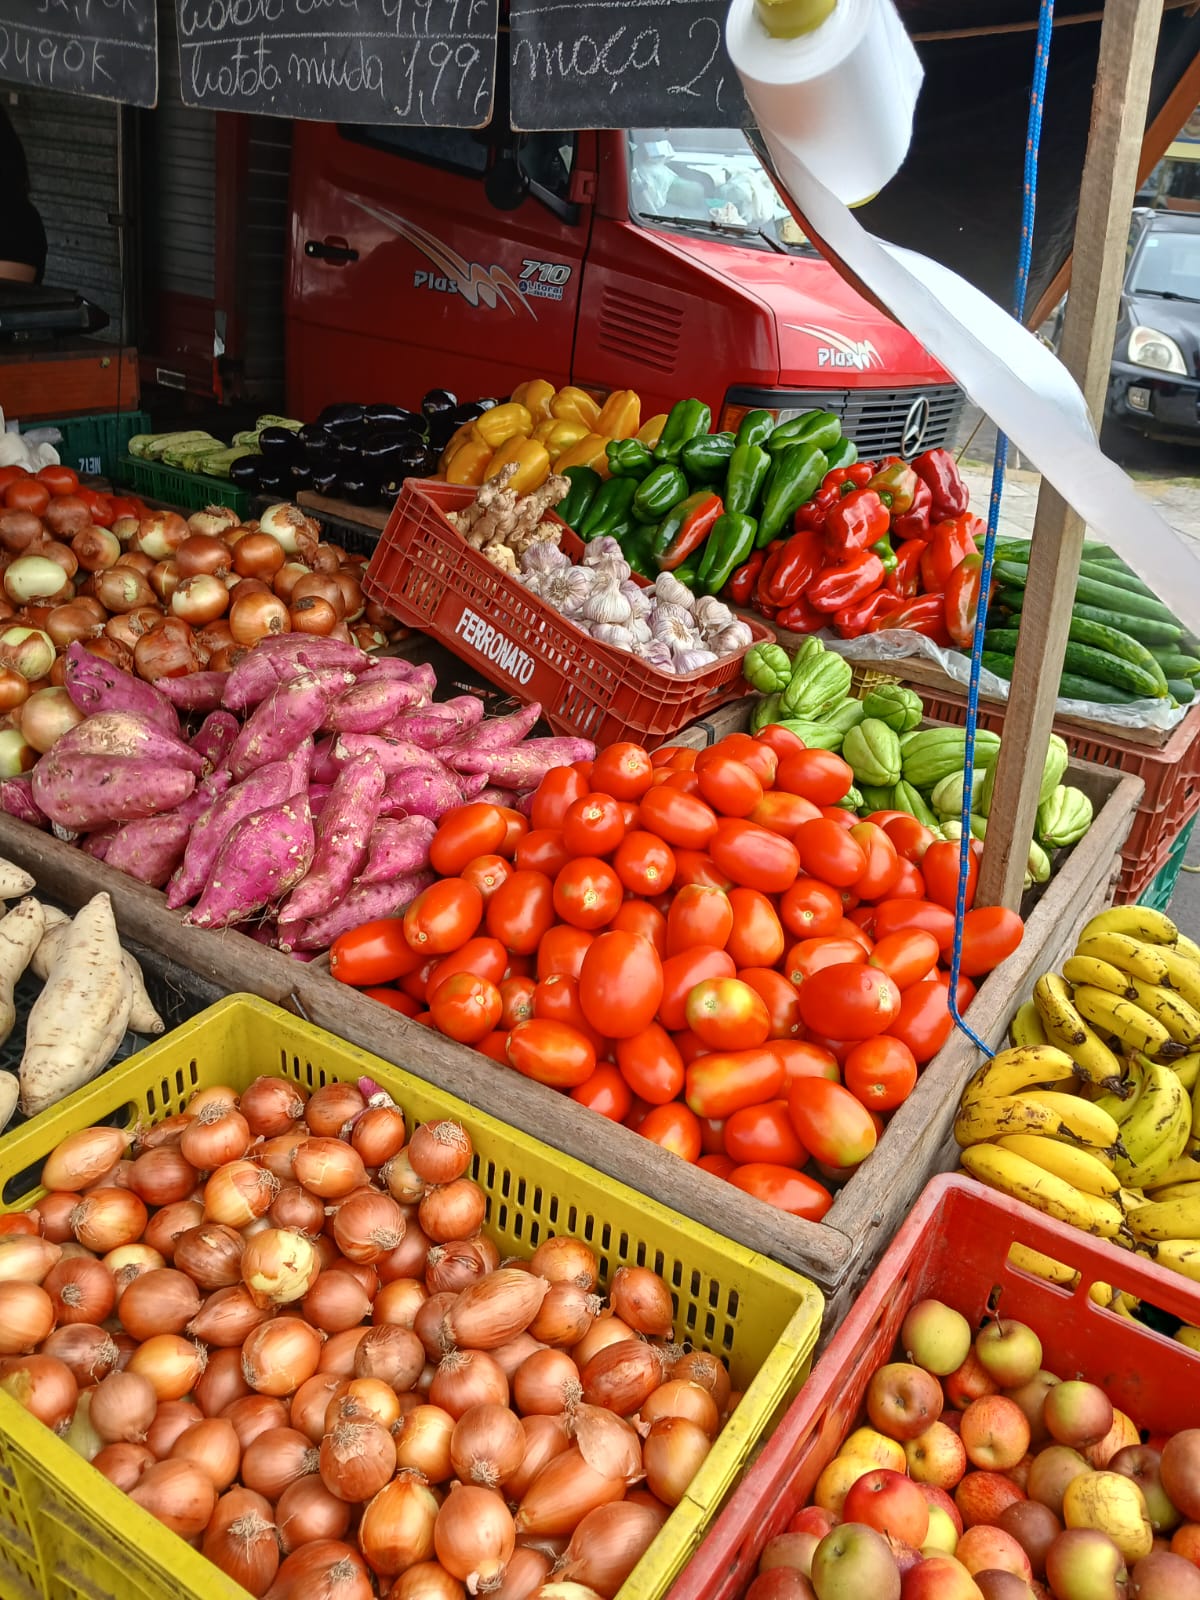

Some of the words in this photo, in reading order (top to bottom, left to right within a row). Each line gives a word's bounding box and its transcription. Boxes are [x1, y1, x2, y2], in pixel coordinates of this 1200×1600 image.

[512, 26, 660, 95] moça
[519, 259, 571, 285] 710
[455, 607, 535, 685] FERRONATO
